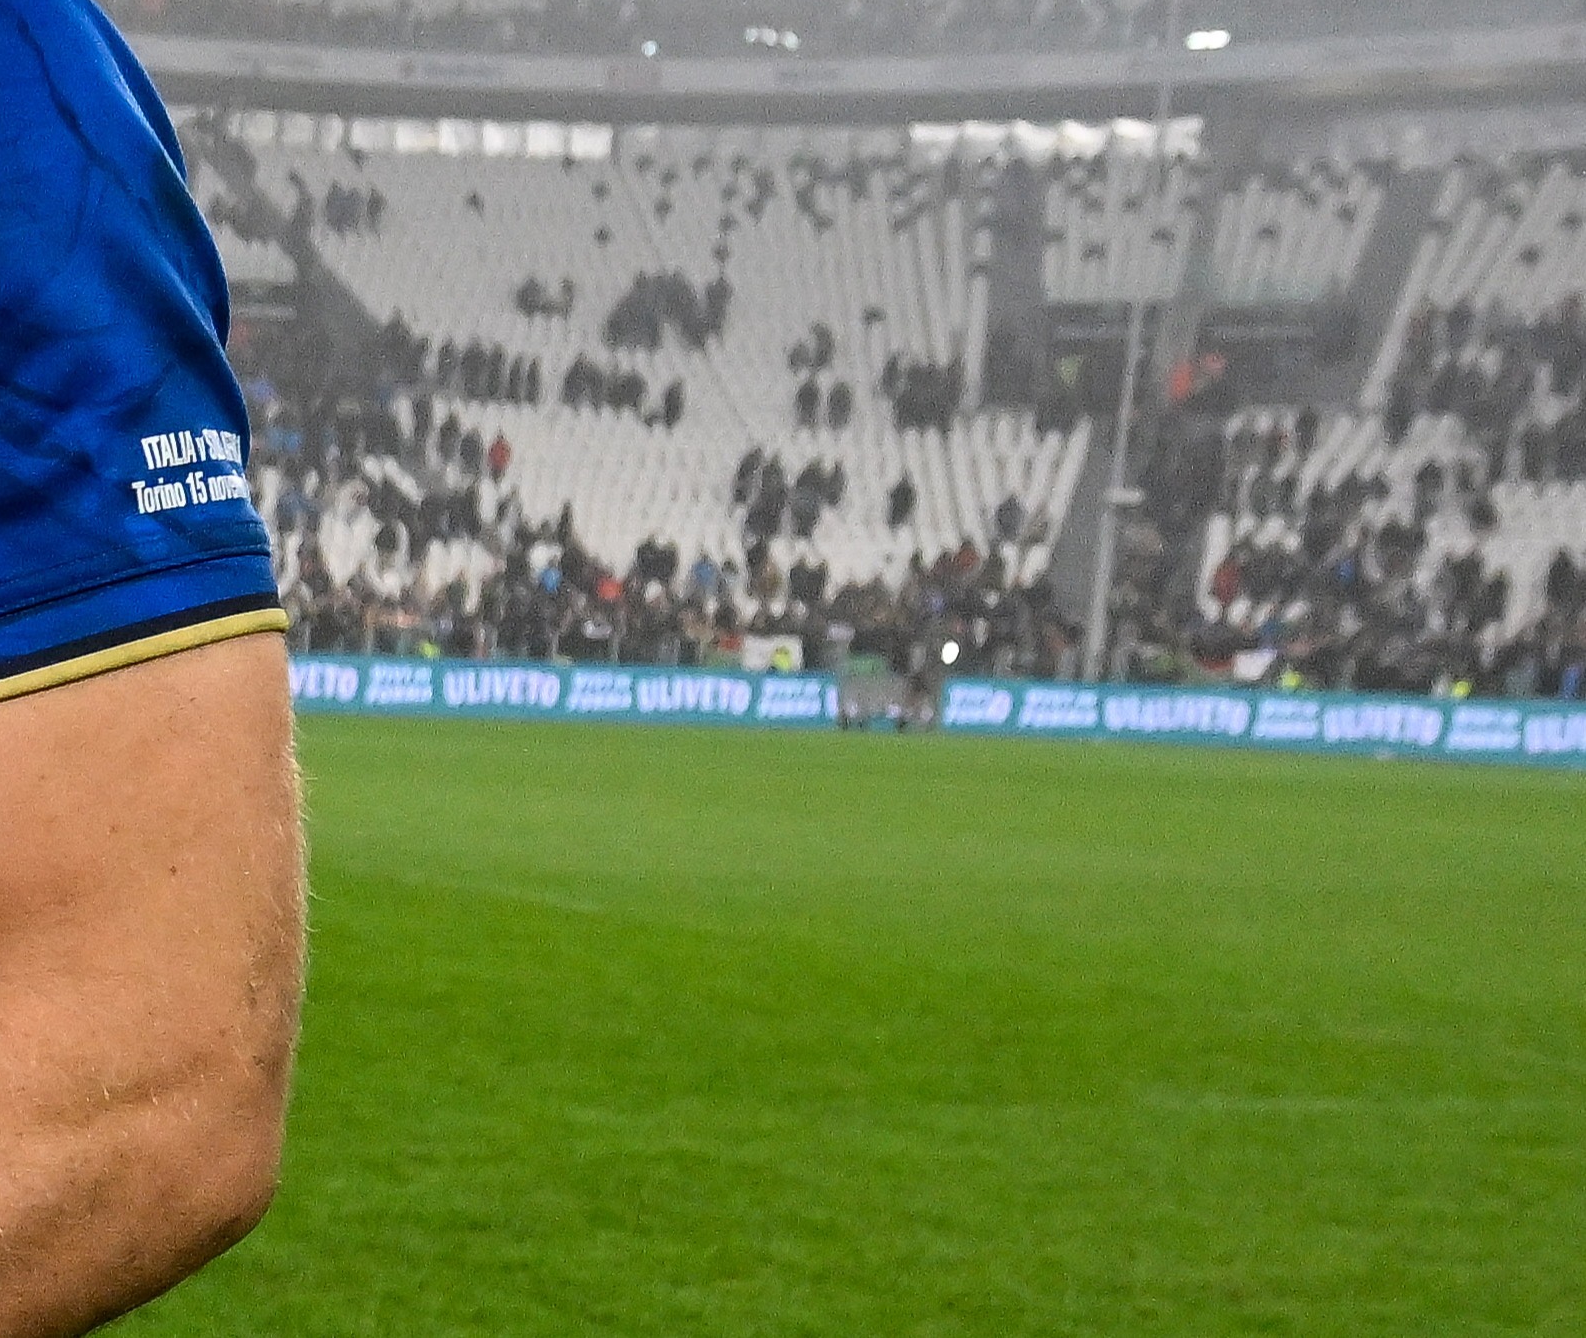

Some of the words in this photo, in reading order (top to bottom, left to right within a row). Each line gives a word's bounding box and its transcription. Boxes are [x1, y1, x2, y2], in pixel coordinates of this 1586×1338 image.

[141, 430, 197, 470] ITALIA
[132, 477, 187, 515] Torino
[185, 471, 208, 505] 15
[289, 662, 359, 704] VETO
[443, 669, 560, 708] ULIVETO
[637, 676, 752, 715] ULIVETO
